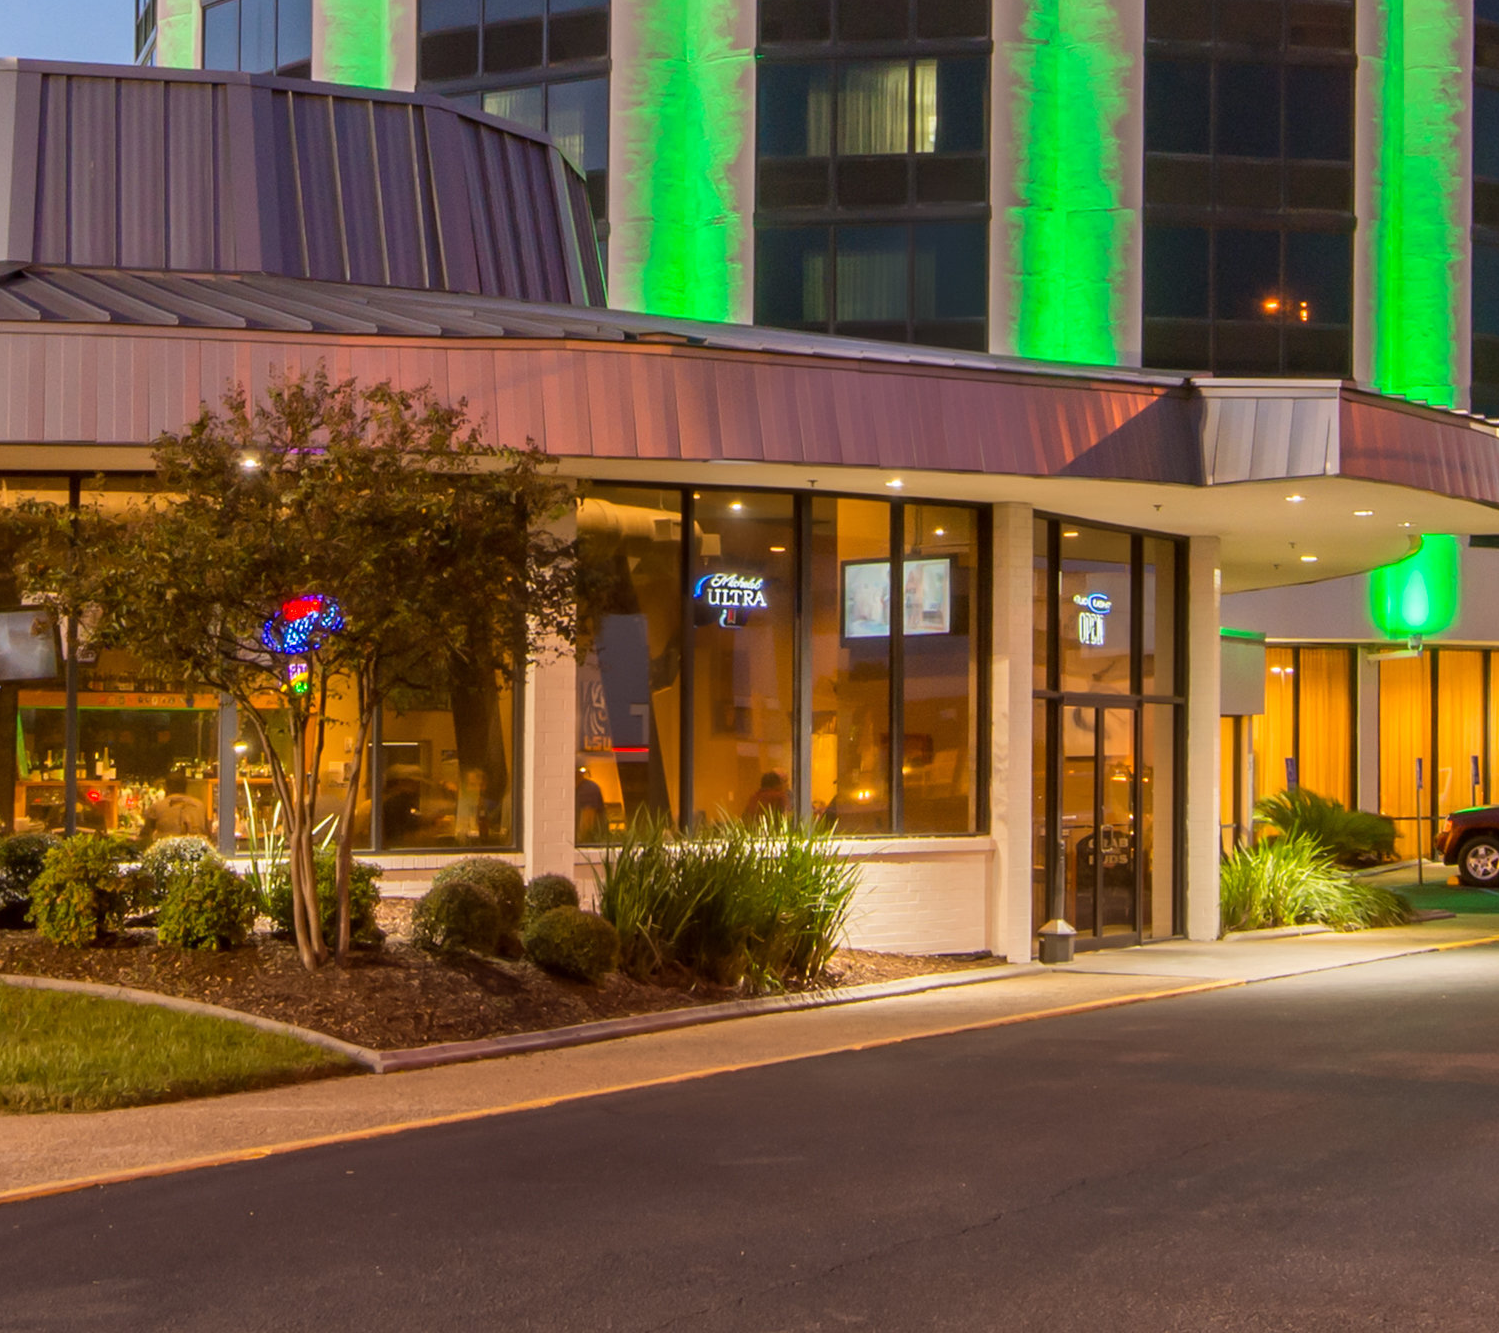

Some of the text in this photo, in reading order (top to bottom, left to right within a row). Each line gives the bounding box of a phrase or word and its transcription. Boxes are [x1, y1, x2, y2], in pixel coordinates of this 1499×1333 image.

[707, 588, 768, 608] ULTRA
[1078, 611, 1105, 645] OPEN
[584, 735, 613, 751] LSU
